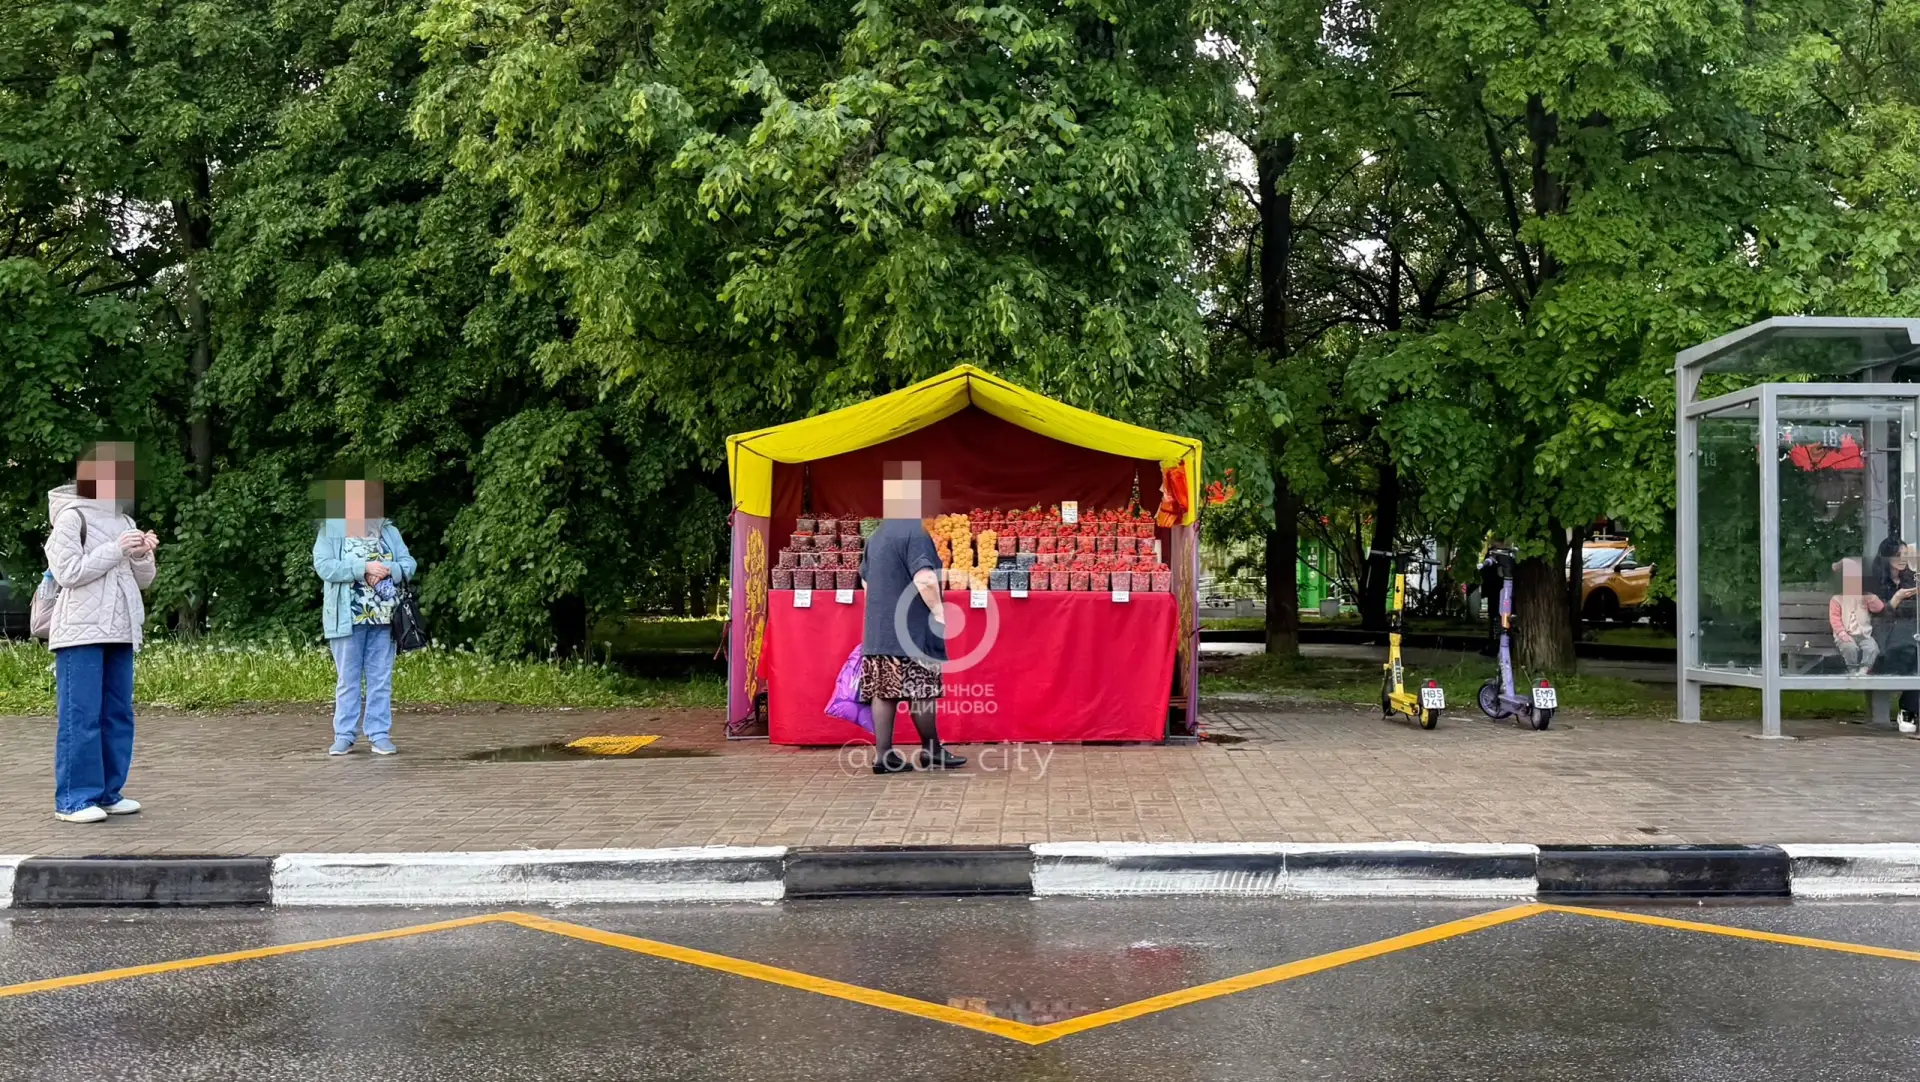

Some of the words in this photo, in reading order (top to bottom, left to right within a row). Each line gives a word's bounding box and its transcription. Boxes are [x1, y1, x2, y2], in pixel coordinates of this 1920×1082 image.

[1422, 689, 1442, 698] HB5
[1535, 688, 1553, 698] EM9
[1424, 698, 1443, 707] 74T
[1535, 698, 1555, 707] 52T
